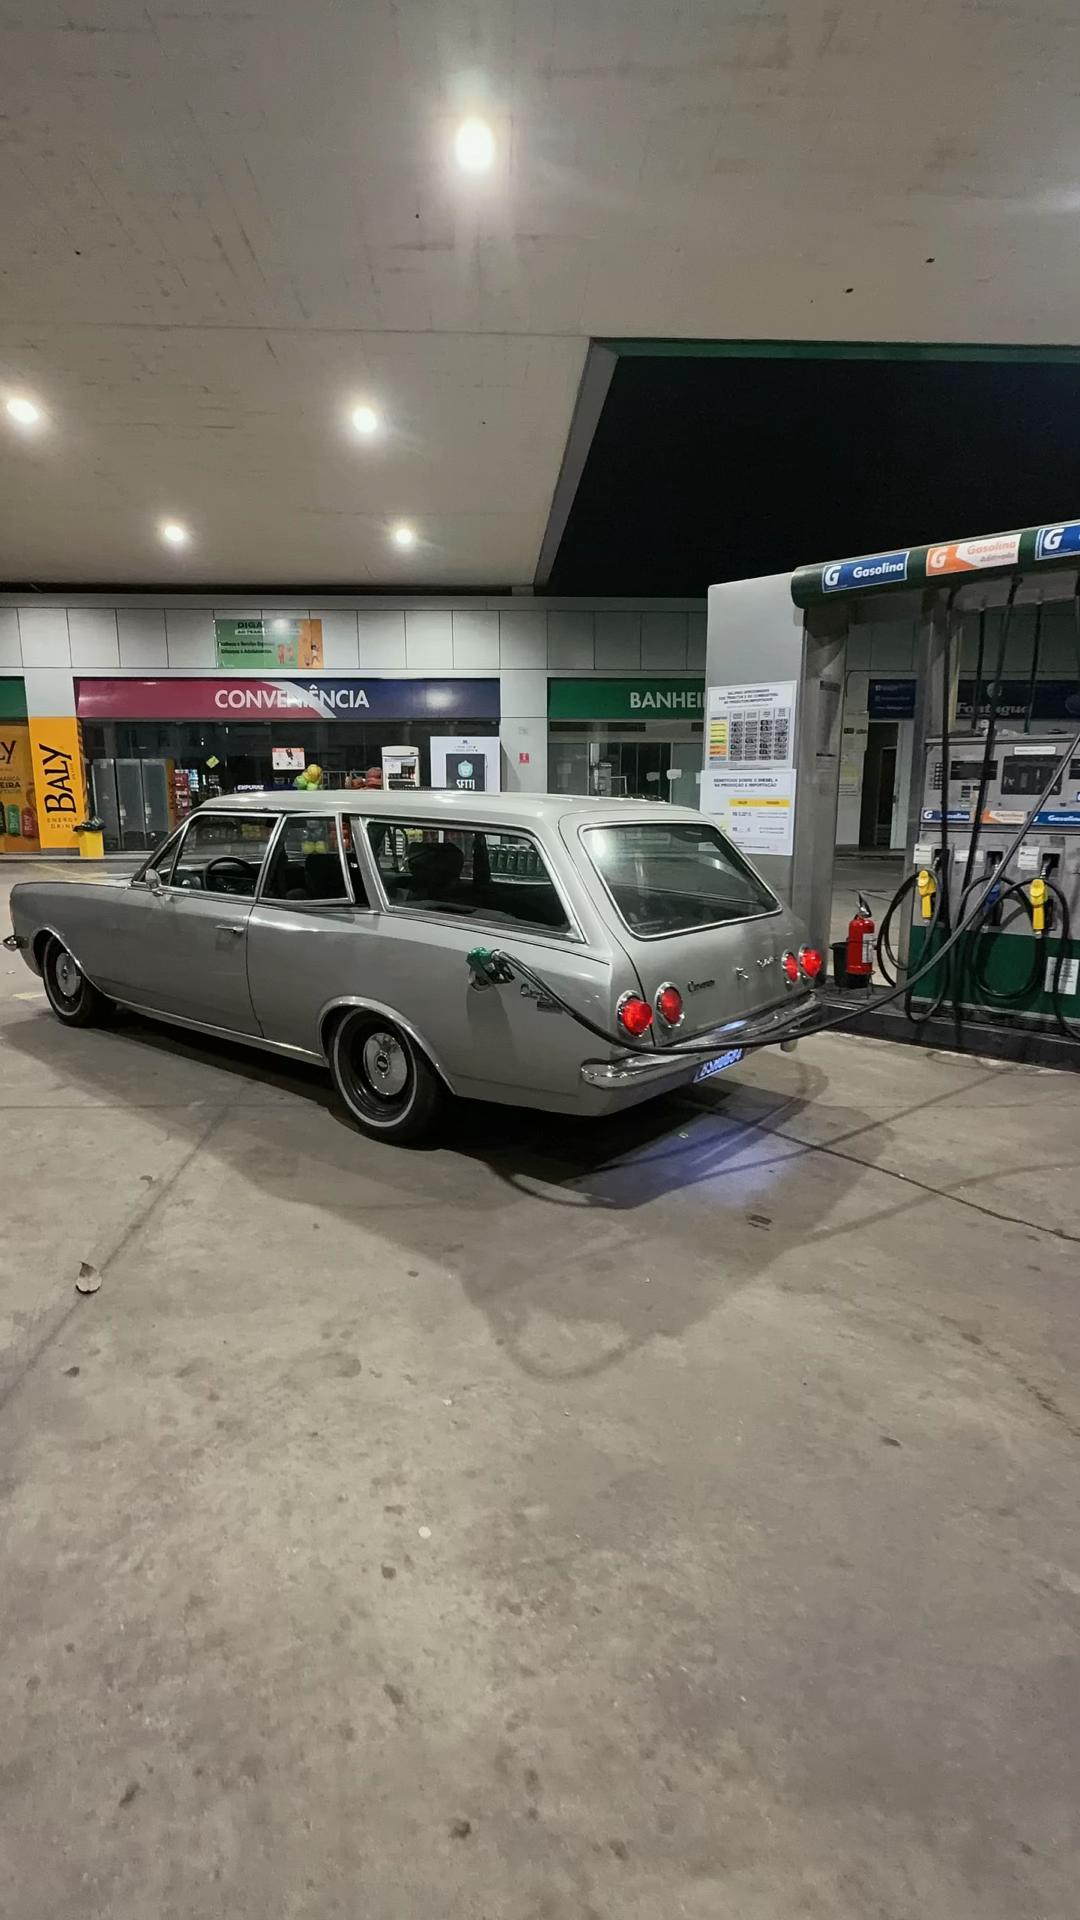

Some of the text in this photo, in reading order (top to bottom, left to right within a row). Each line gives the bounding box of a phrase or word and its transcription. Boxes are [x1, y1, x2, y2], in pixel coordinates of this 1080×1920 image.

[1043, 528, 1065, 550] G
[931, 541, 1017, 569] G Gasolina
[825, 562, 905, 586] G Gasolina
[214, 683, 370, 709] CONVENIÊNCIA
[630, 691, 705, 708] BANHEI
[38, 743, 77, 814] BALY
